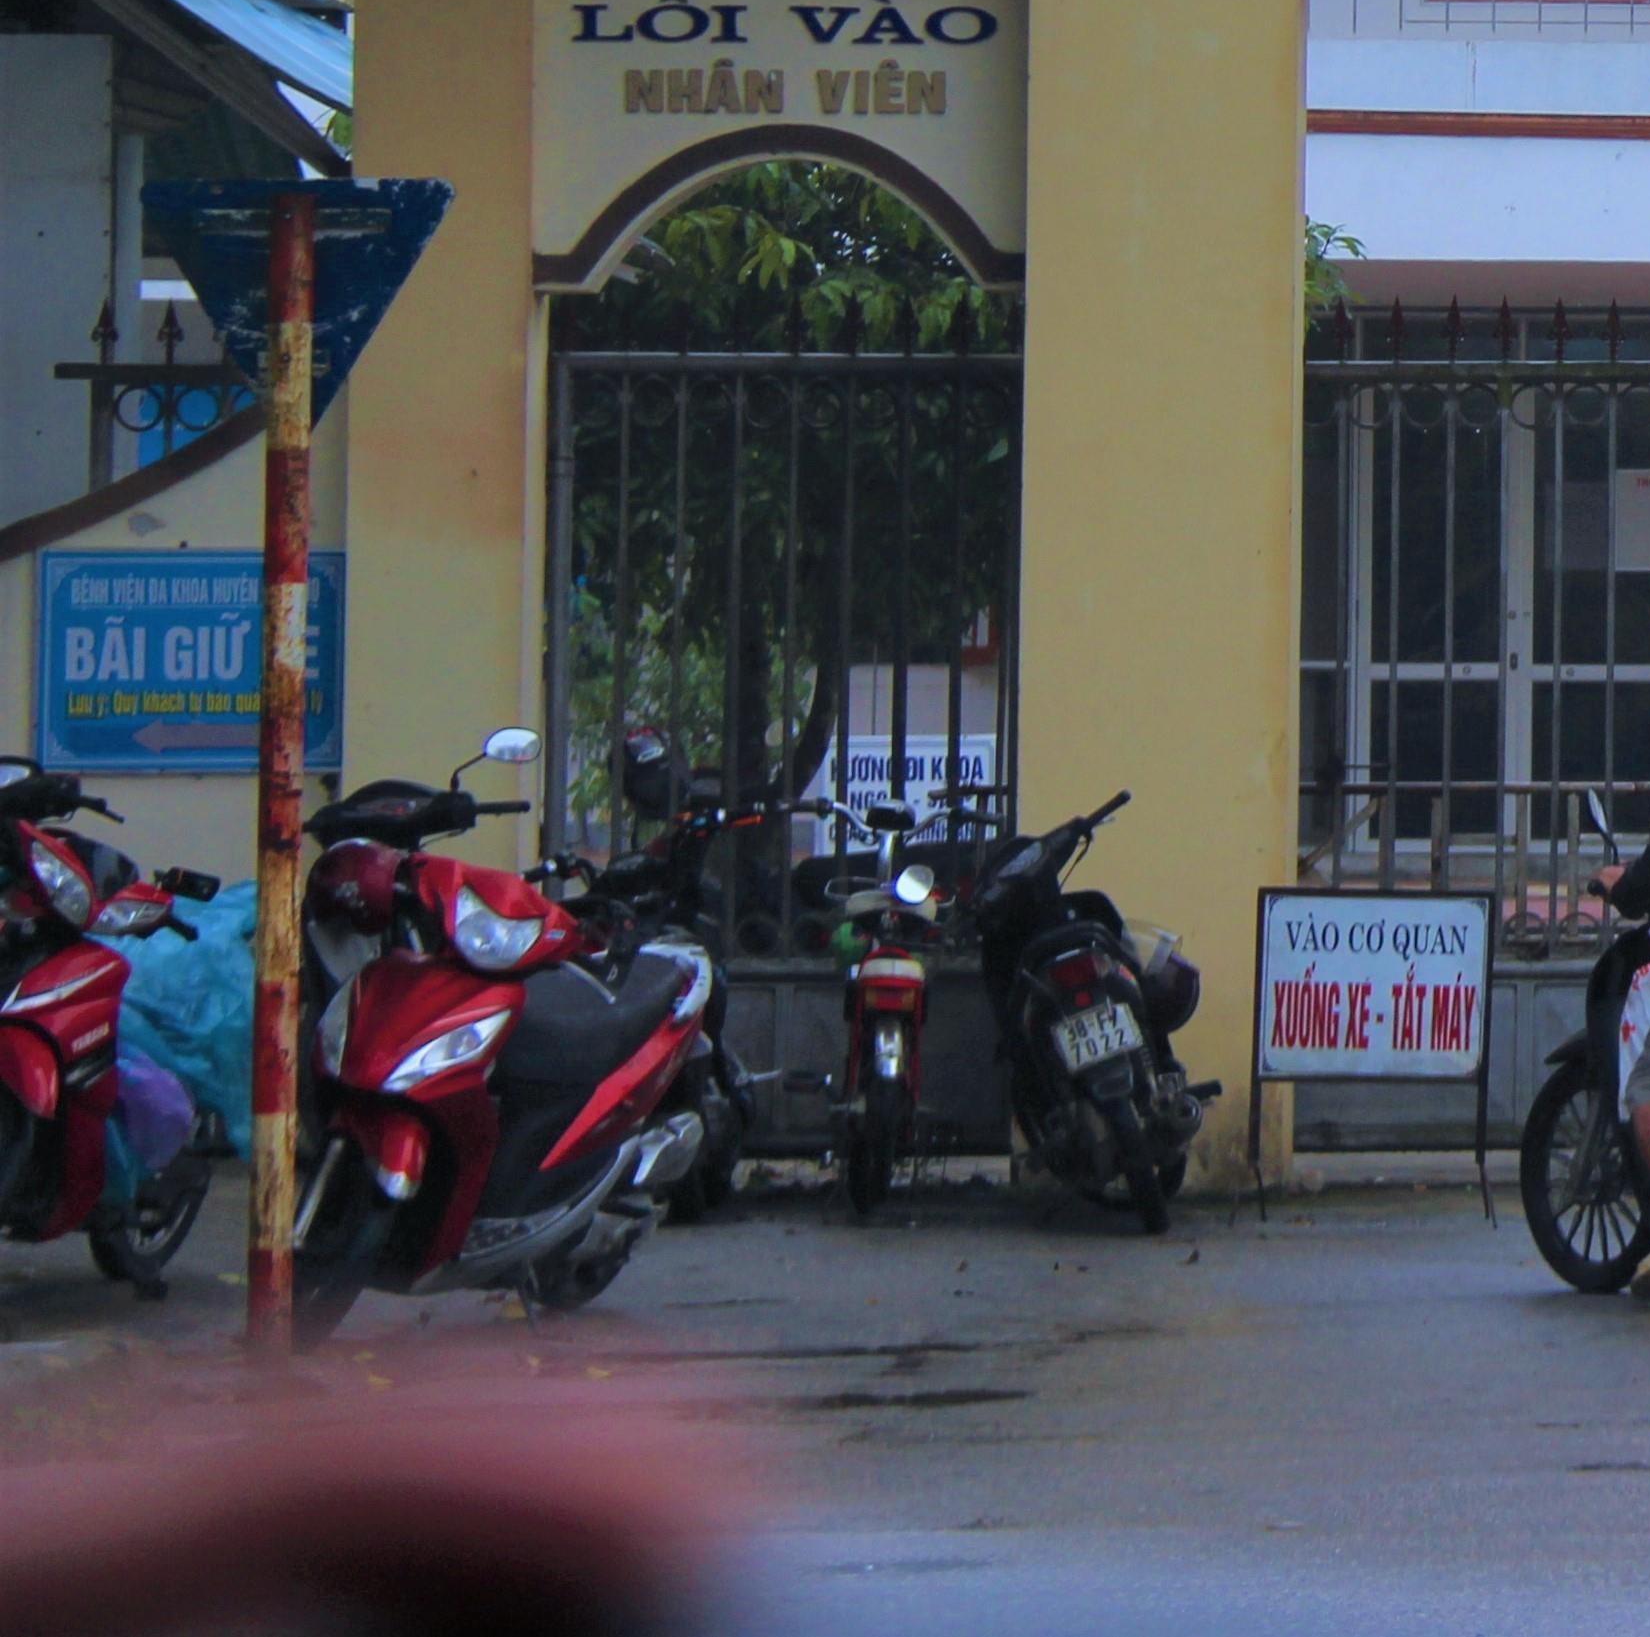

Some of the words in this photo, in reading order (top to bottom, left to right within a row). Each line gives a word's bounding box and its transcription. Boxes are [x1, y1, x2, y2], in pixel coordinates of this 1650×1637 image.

[625, 56, 783, 113] NHÂN
[816, 58, 947, 114] VIÊN
[172, 577, 209, 604] KHOA
[65, 616, 146, 682] BÃI
[164, 613, 252, 682] GIỮ
[932, 754, 984, 782] KOA
[1286, 912, 1340, 953] VÀO
[1348, 919, 1386, 954] CƠ
[1392, 923, 1468, 962] QUAN
[1271, 961, 1341, 1050] XUỐNG
[1392, 962, 1427, 1052] TẮT
[1430, 972, 1476, 1052] MÁY
